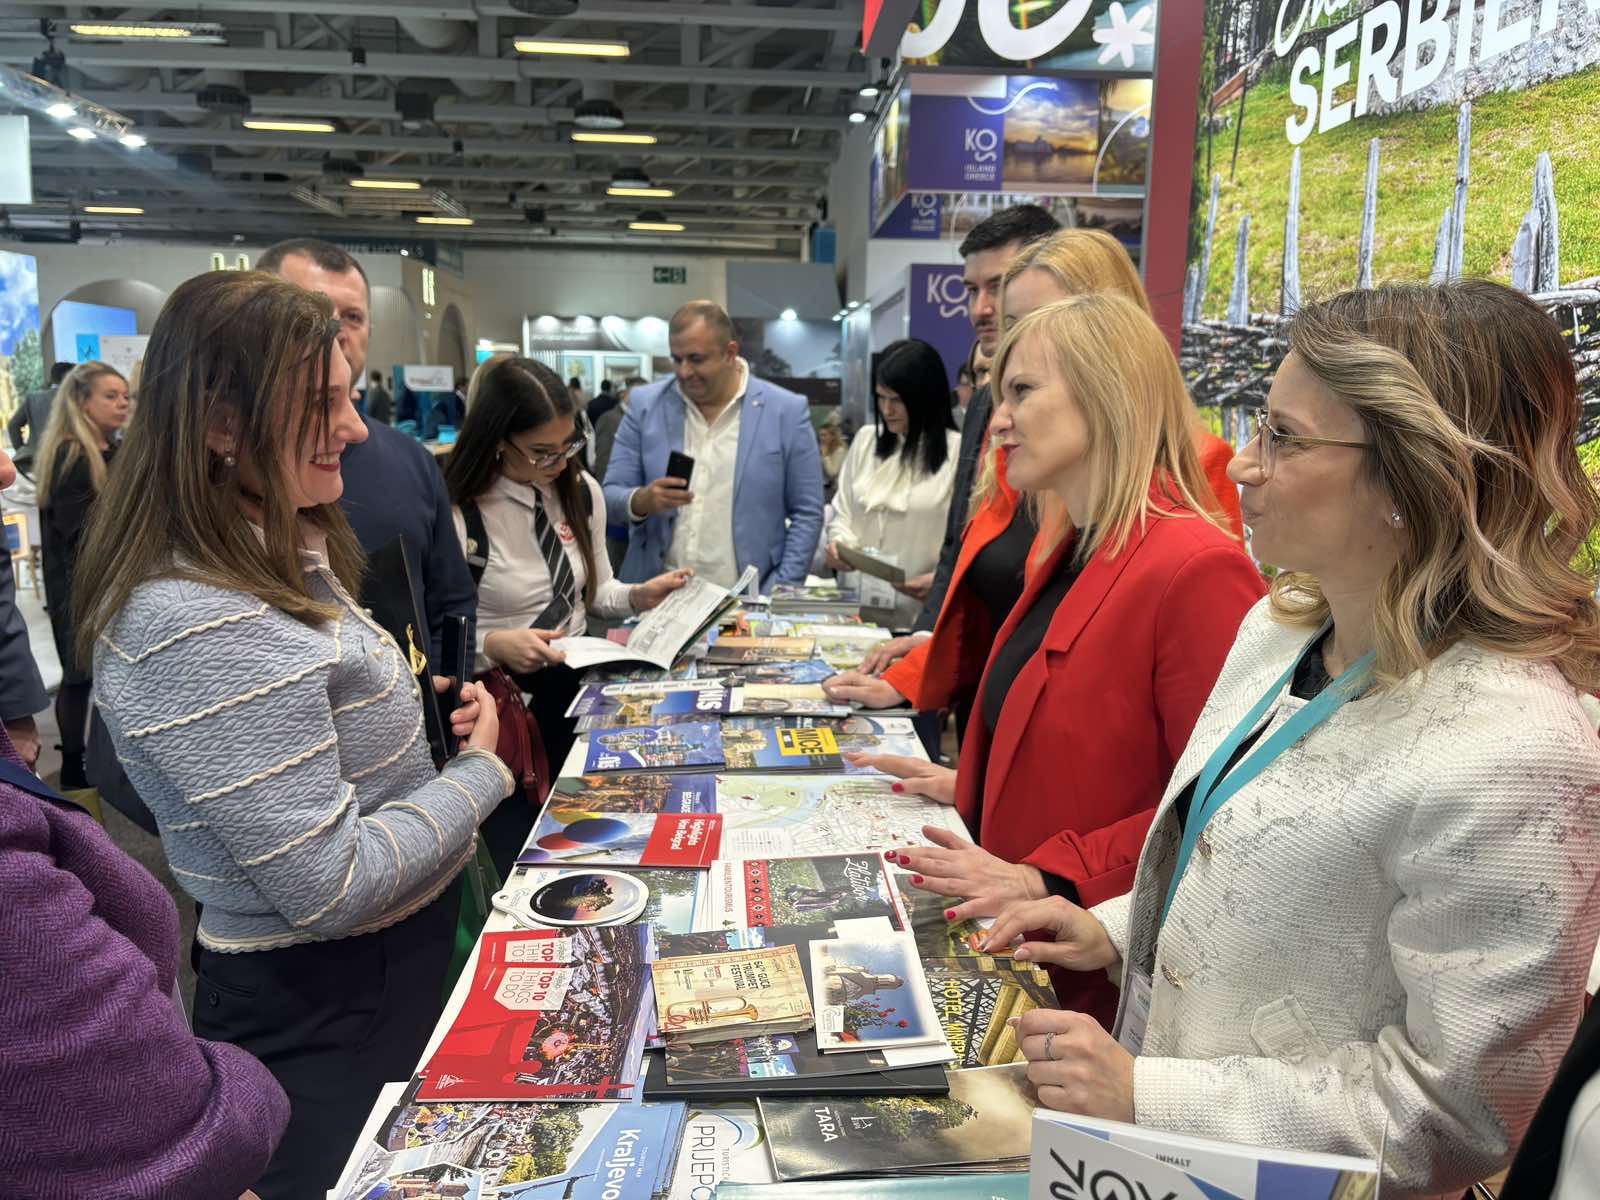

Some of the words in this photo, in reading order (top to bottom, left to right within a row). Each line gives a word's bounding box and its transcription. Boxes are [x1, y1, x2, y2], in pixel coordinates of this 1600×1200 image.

[795, 729, 823, 754] MICE
[677, 819, 690, 830] Von
[687, 819, 705, 846] Highlights
[724, 862, 734, 912] FAMILIENTOURISMUS
[542, 942, 554, 962] TOP
[509, 971, 525, 983] TO
[515, 971, 540, 1004] THINGS
[538, 971, 555, 989] TOP
[730, 964, 745, 990] FESTIVAL
[742, 962, 759, 989] TRUMPET
[502, 984, 519, 999] DO
[532, 991, 547, 1002] 10
[944, 980, 963, 1017] HOTEL
[947, 1023, 966, 1062] MINERA
[814, 1107, 839, 1142] TARA
[602, 1129, 641, 1200] Kraljevo
